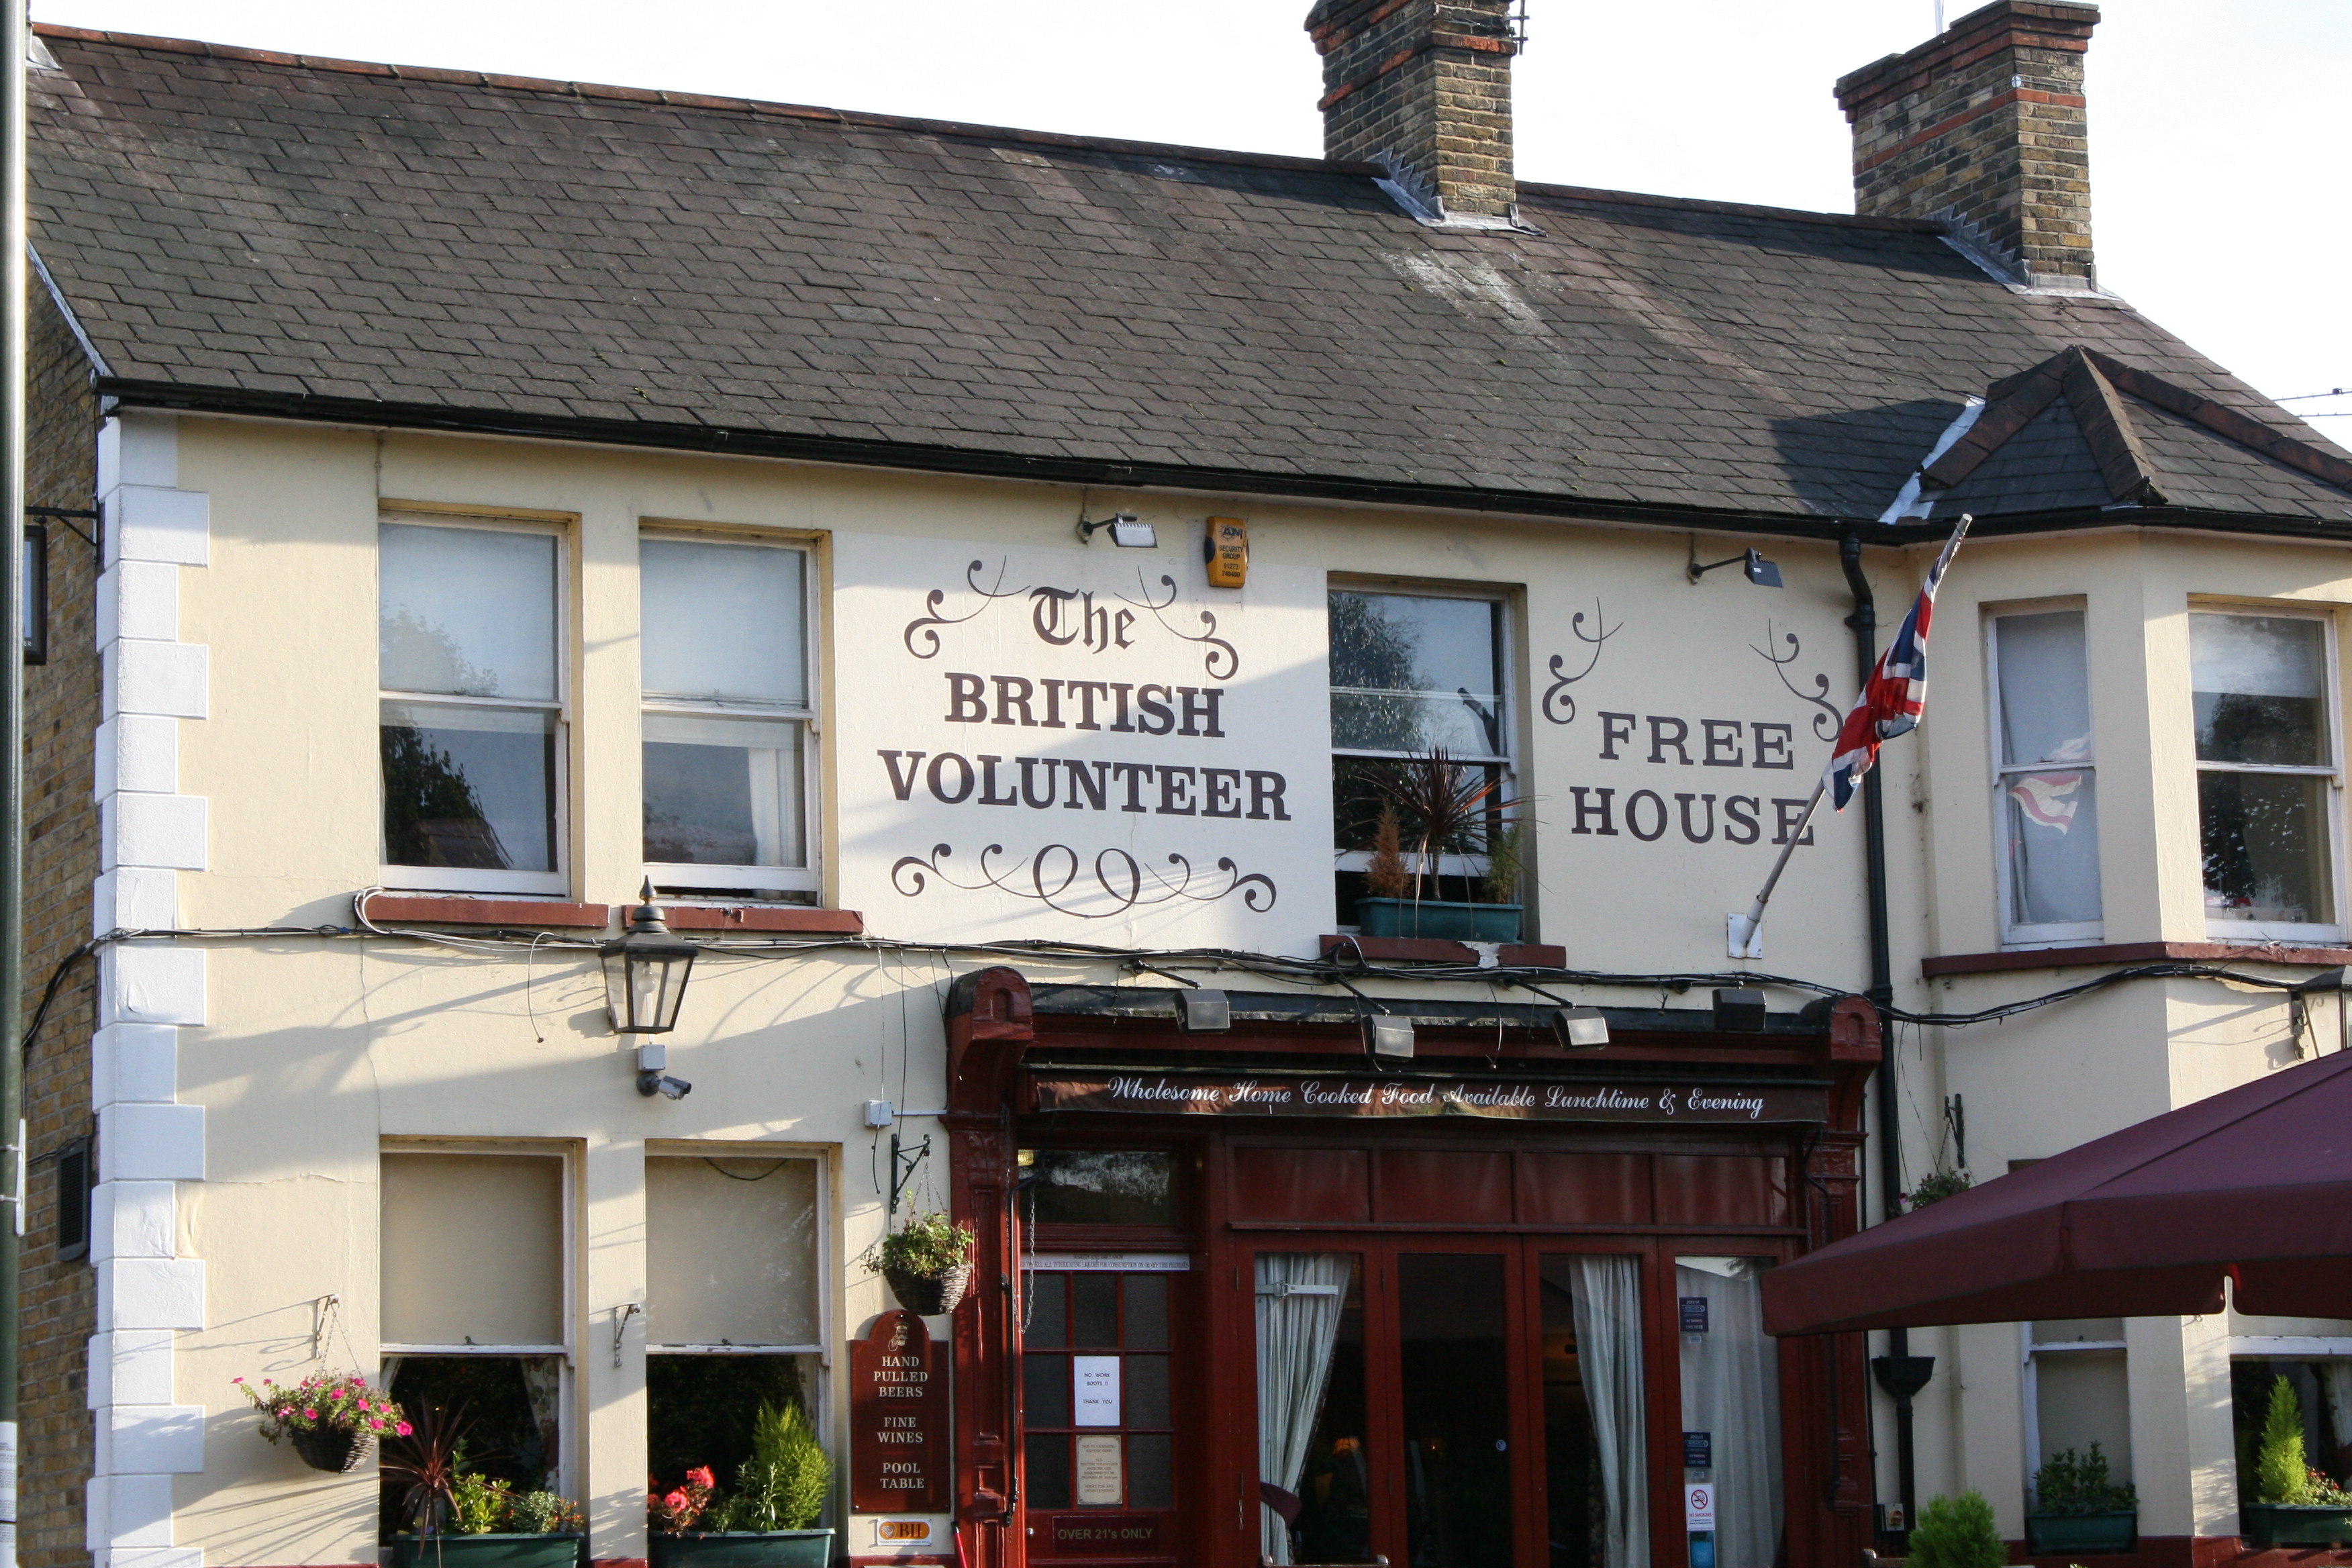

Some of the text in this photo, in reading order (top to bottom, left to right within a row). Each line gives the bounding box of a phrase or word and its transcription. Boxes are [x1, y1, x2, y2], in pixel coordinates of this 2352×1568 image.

[1028, 586, 1136, 654] The
[944, 672, 1225, 738] BRITISH
[1598, 711, 1794, 770] FREE
[877, 749, 1291, 821] VOLUNTEER
[1569, 785, 1814, 846] HOUSE
[1108, 1076, 1764, 1119] Wholesome Home Cooked Food Available Lunchtime & Evening
[881, 1356, 920, 1367] HAND
[873, 1371, 928, 1382] PULLED
[878, 1386, 923, 1397] BEERS
[883, 1417, 916, 1428] FINE
[877, 1432, 924, 1443] WINES
[882, 1462, 920, 1473] POOL
[880, 1478, 925, 1489] TABLE
[1057, 1528, 1153, 1540] OVER 21's ONLY
